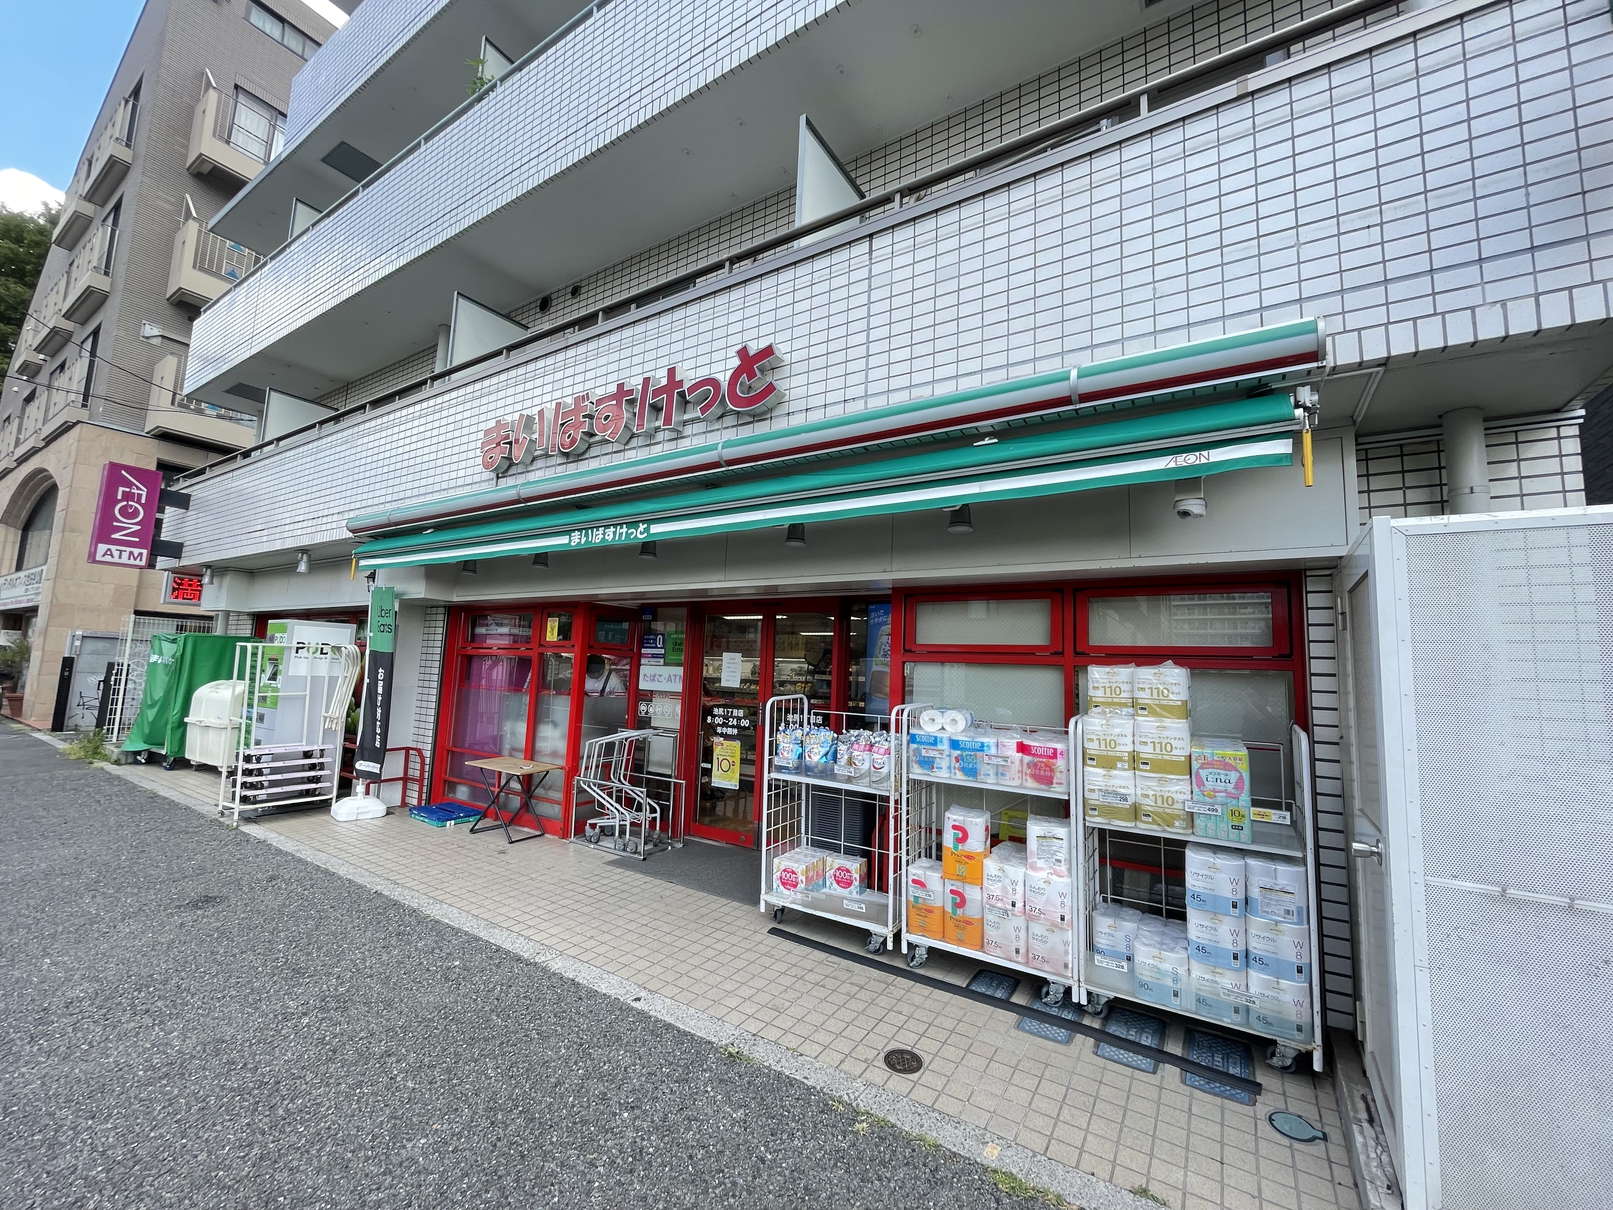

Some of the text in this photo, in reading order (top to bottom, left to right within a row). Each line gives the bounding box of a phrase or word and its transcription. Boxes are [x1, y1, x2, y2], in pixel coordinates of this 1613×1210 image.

[480, 344, 780, 472] まいばすけっと
[570, 523, 648, 546] まいばすけっと
[101, 548, 144, 562] ATM
[170, 577, 202, 602] 満
[1101, 685, 1122, 696] 110
[1148, 686, 1170, 698] 110
[1095, 738, 1117, 749] 110
[1149, 741, 1173, 753] 110
[1152, 793, 1175, 806] 110
[1229, 877, 1240, 885] W
[1229, 928, 1240, 938] W
[1292, 939, 1304, 949] W
[1292, 999, 1304, 1008] W
